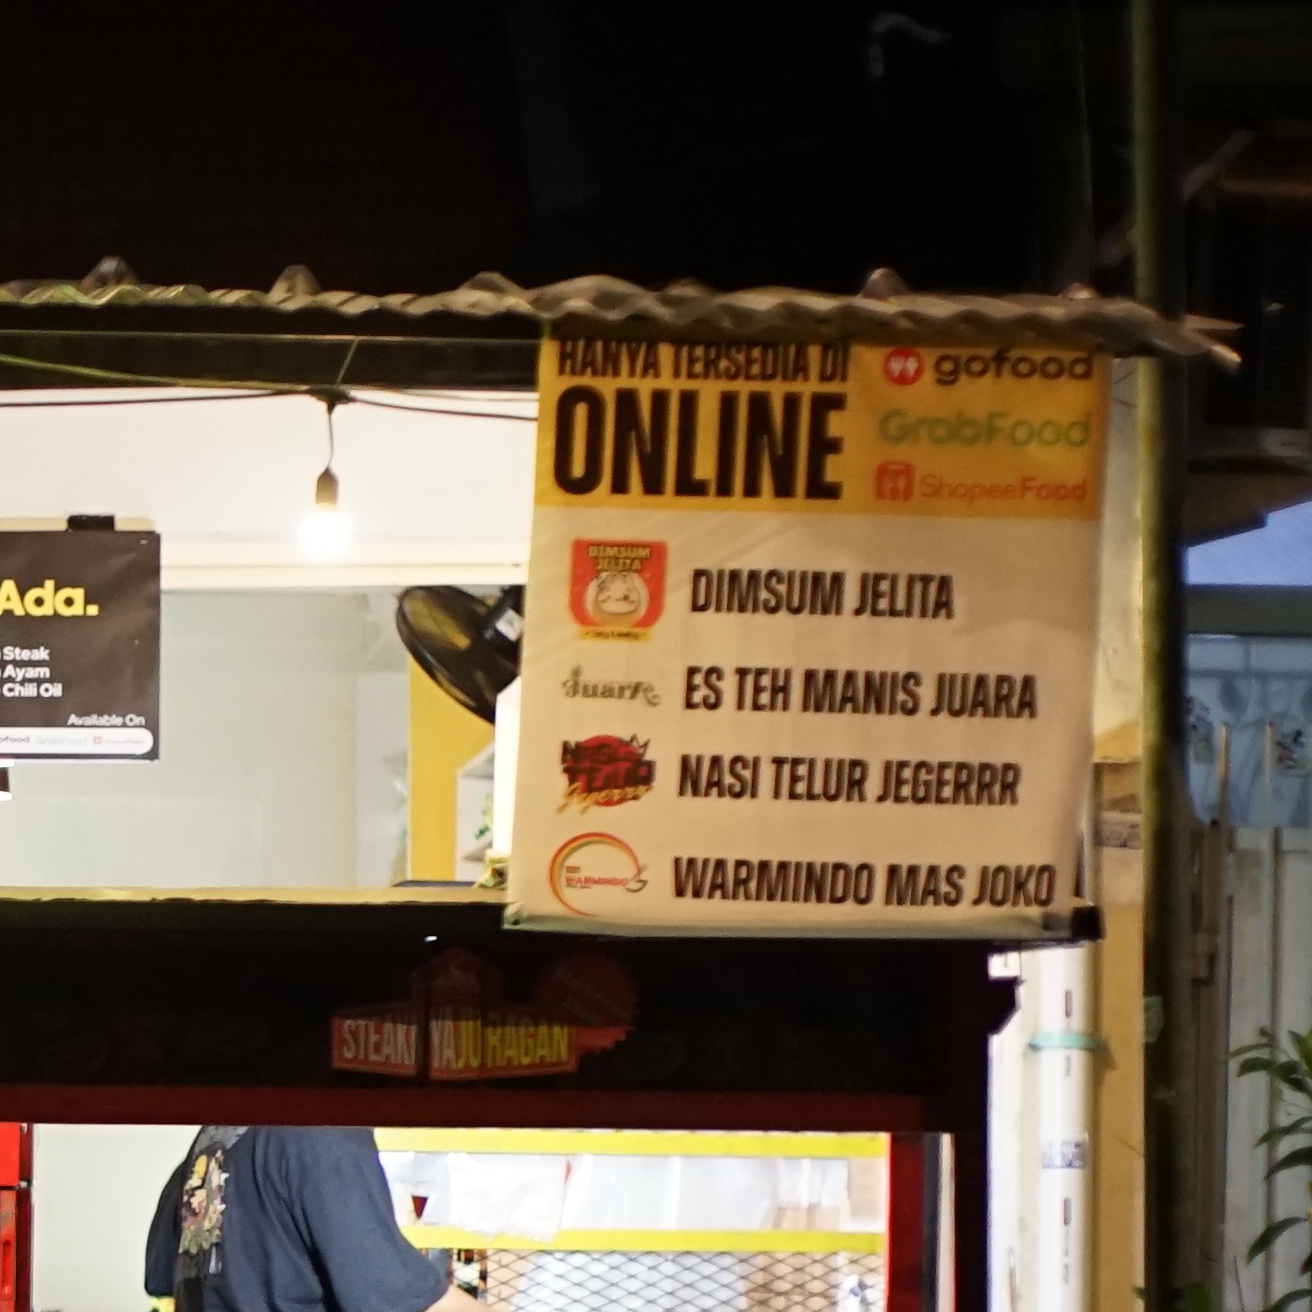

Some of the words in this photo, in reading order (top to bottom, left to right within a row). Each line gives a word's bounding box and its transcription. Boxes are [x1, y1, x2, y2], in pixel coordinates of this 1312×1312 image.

[557, 340, 663, 379] HANYA
[673, 341, 810, 381] TERSEDIA
[818, 342, 850, 383] DI
[934, 349, 1094, 387] gofood
[553, 385, 848, 499] ONLINE
[878, 408, 1093, 447] GrabFood
[920, 474, 1088, 504] ShopeeFood
[689, 567, 845, 617] DIMSUM
[853, 571, 956, 620] JELITA
[3, 646, 51, 661] Steak
[3, 664, 50, 681] Ayam
[3, 682, 37, 698] Chili
[39, 682, 63, 698] Oil
[684, 666, 726, 711] ES
[734, 667, 794, 712] TEH
[801, 668, 921, 717] MANIS
[931, 673, 1039, 720] JUARA
[67, 714, 124, 726] Available
[125, 714, 146, 726] On
[678, 754, 761, 799] NASI
[771, 758, 869, 803] TELUR
[876, 760, 1022, 806] JEGERRR
[673, 856, 877, 905] WARMINDO
[884, 863, 965, 907] MAS
[972, 865, 1056, 908] JOKO
